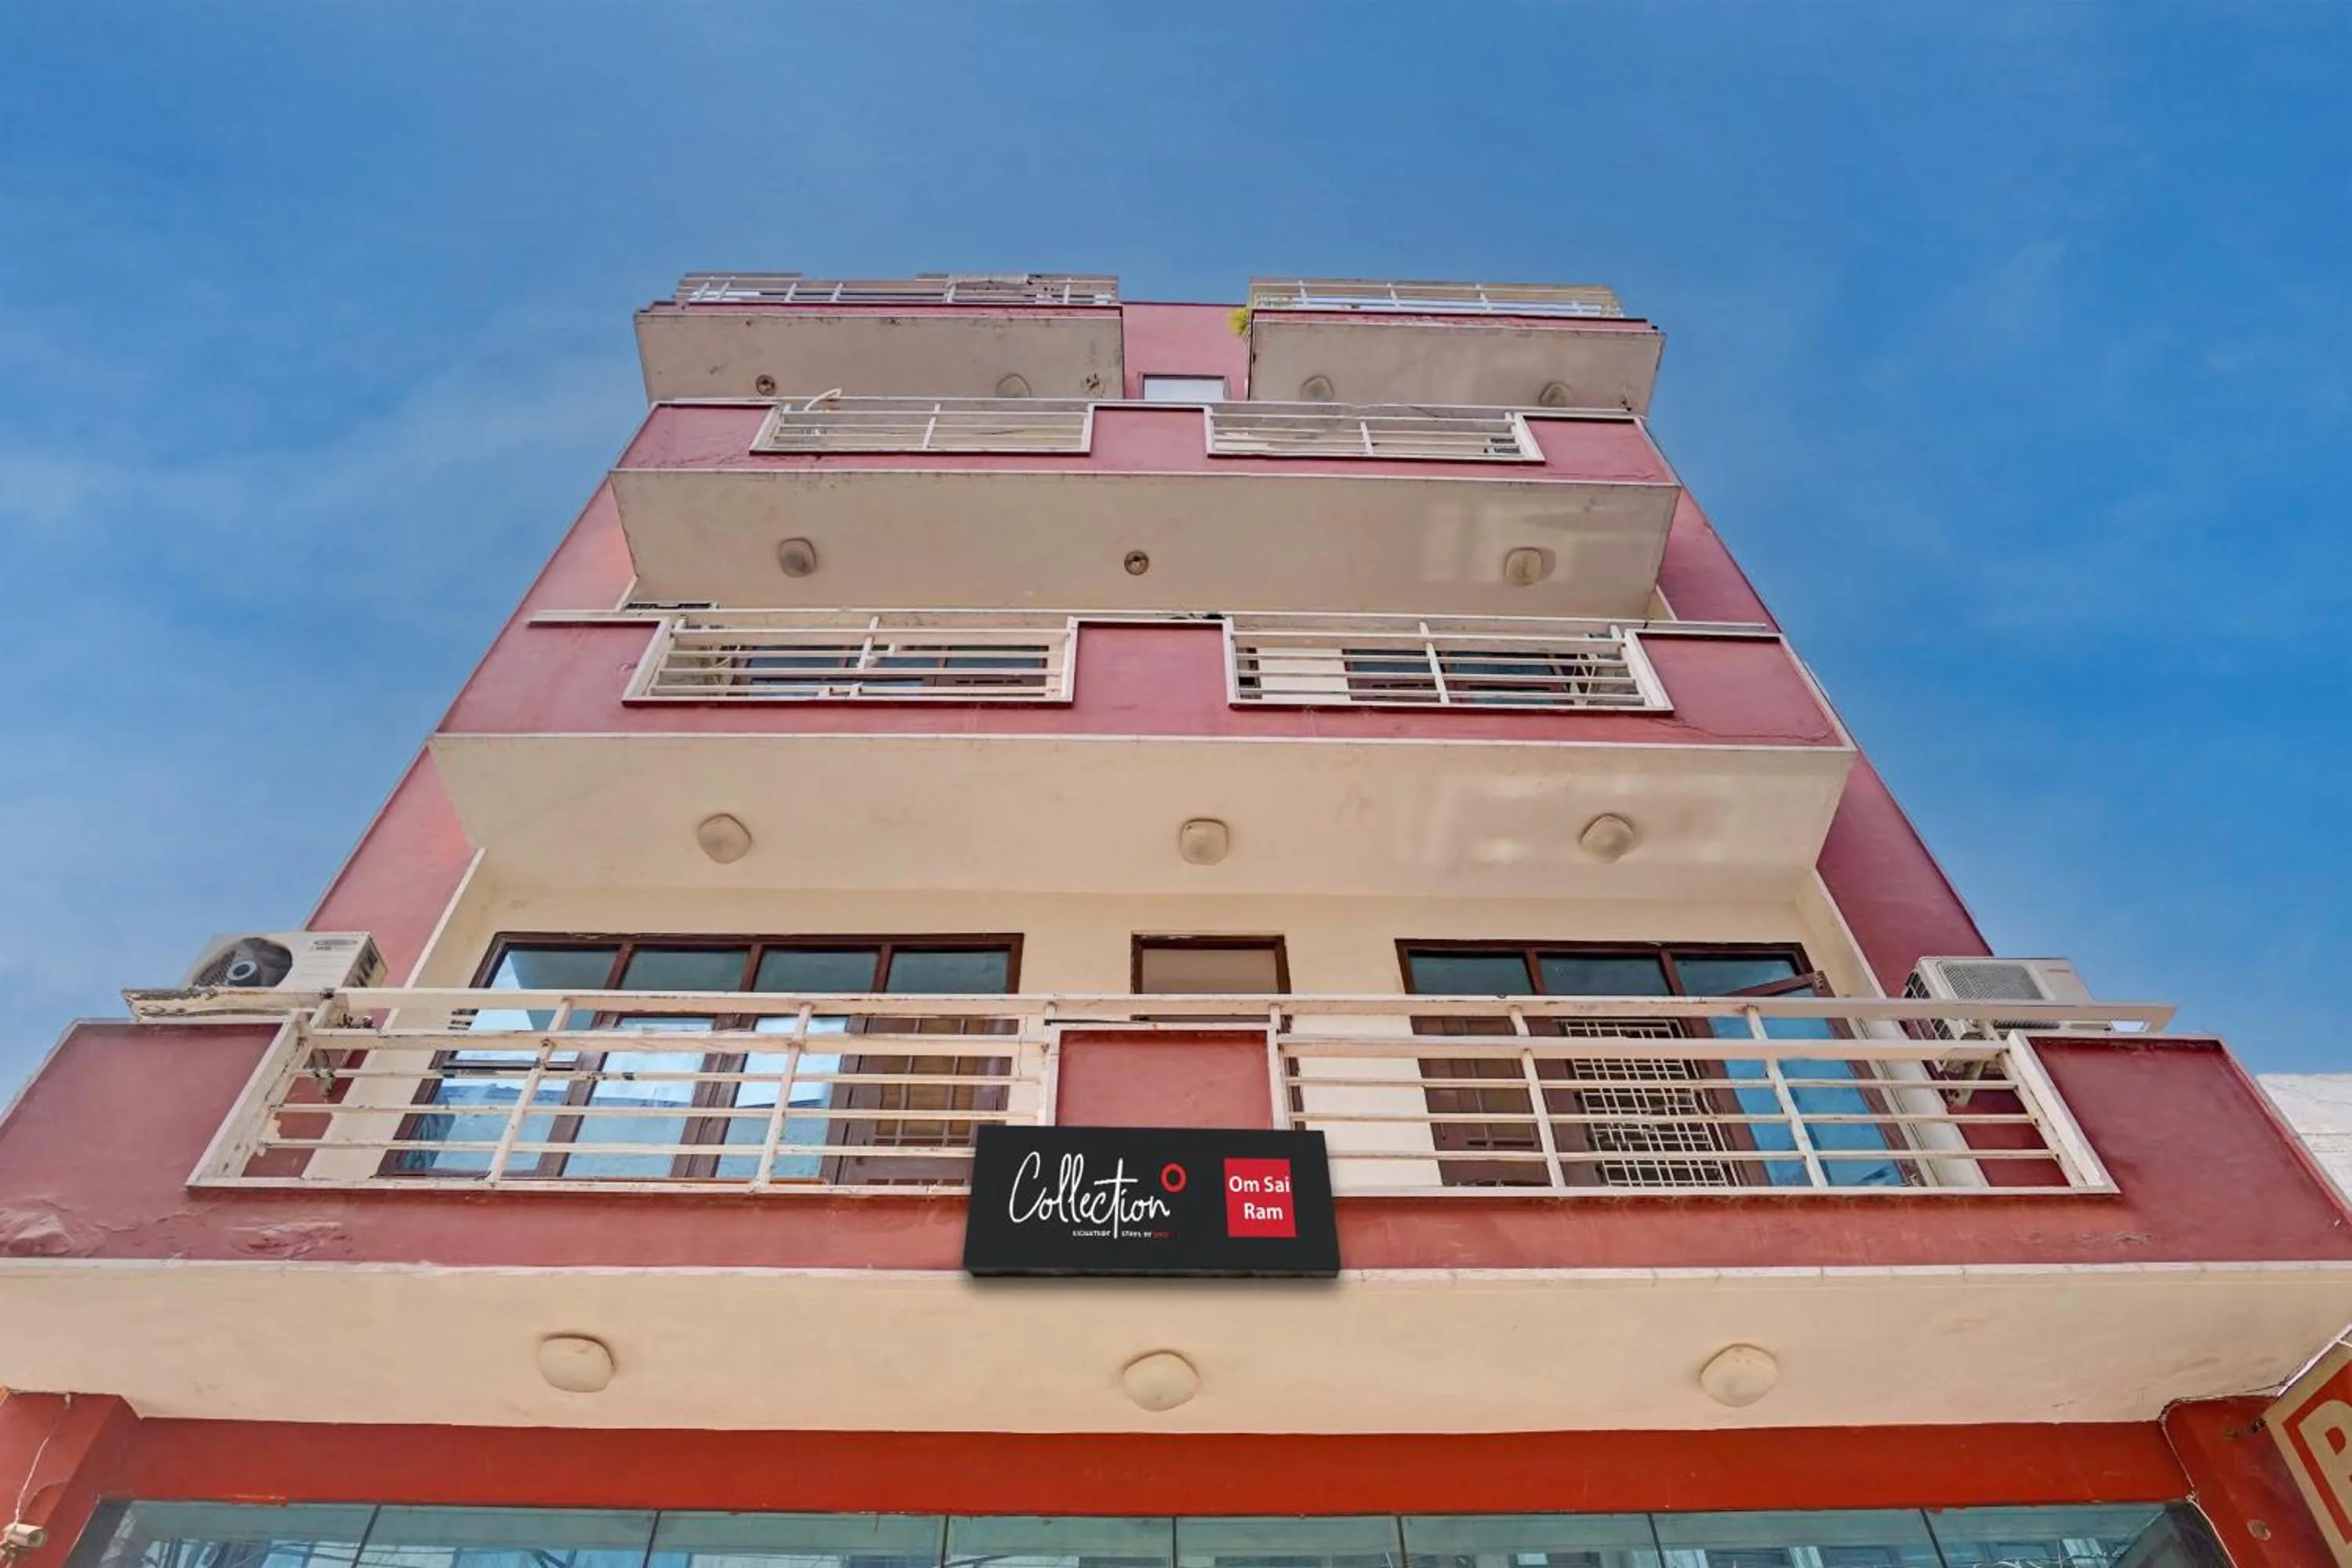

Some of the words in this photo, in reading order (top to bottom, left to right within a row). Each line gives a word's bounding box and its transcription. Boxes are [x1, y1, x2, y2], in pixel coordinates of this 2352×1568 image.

[1229, 1175, 1260, 1192] Om
[1263, 1175, 1290, 1192] Sai
[1009, 1151, 1171, 1239] Collection
[1243, 1202, 1283, 1220] Ram
